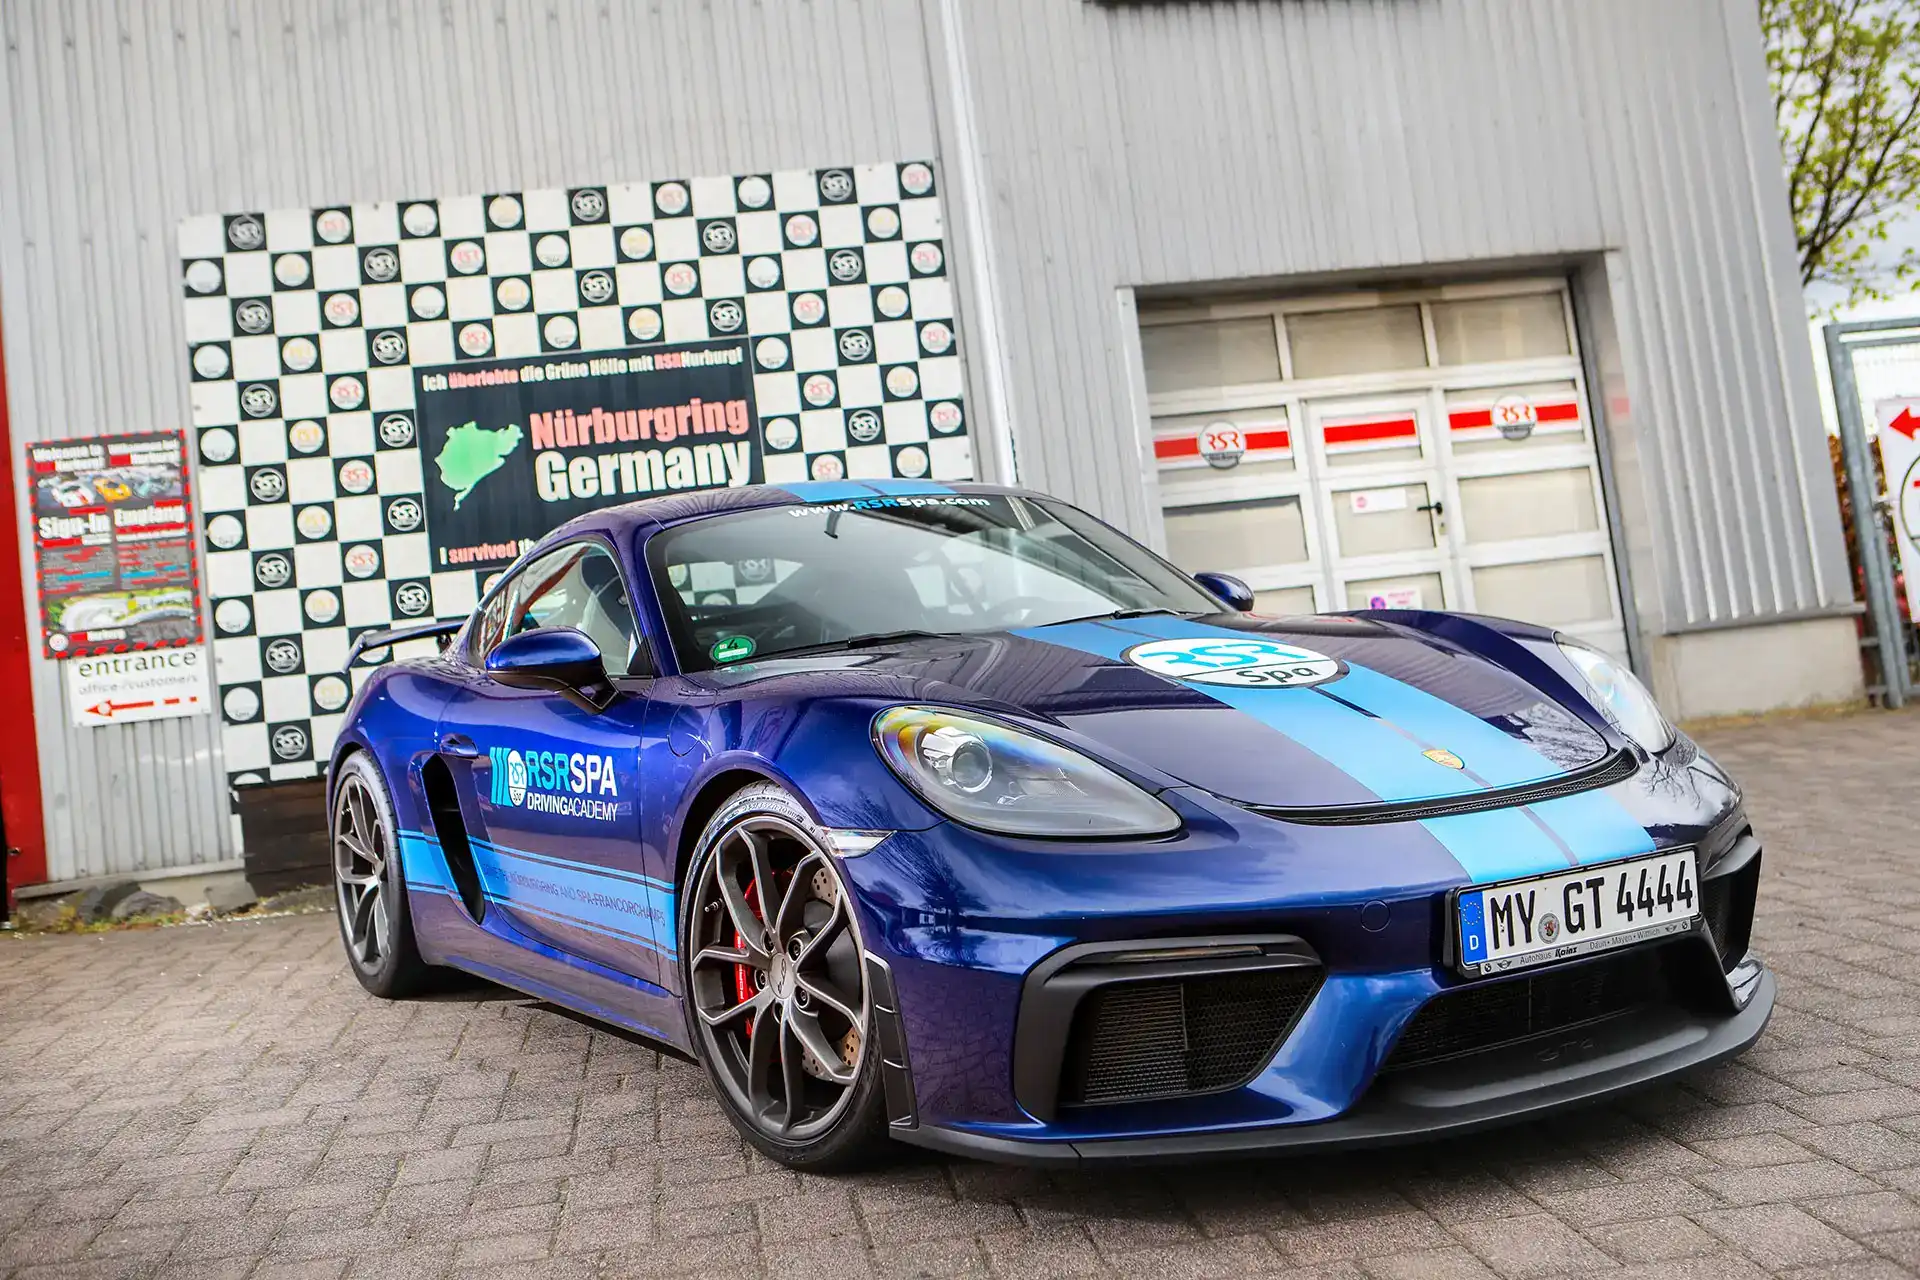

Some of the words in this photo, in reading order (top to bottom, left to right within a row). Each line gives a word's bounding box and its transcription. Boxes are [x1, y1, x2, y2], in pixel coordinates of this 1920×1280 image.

[422, 374, 448, 391] Ich
[448, 368, 519, 389] überlebte
[520, 365, 544, 382] die
[545, 361, 589, 380] Grüne
[589, 357, 627, 376] Hölle
[628, 355, 653, 373] mit
[529, 398, 749, 450] Nürburgring
[535, 441, 751, 502] Germany
[788, 497, 990, 518] www.RSRSpa.com
[440, 547, 447, 565] I
[448, 539, 518, 564] survived
[518, 537, 537, 557] th
[728, 639, 739, 649] 4
[1140, 643, 1308, 668] RSR
[79, 651, 196, 677] entrance
[1236, 667, 1321, 683] Spa
[525, 750, 617, 796] RSRSPA
[527, 792, 618, 821] DRIVINGACADEMY
[1490, 890, 1536, 950] MY
[1563, 876, 1605, 934] GT
[1616, 860, 1693, 922] 4444
[1469, 935, 1479, 951] D
[1519, 952, 1552, 965] Autohaus
